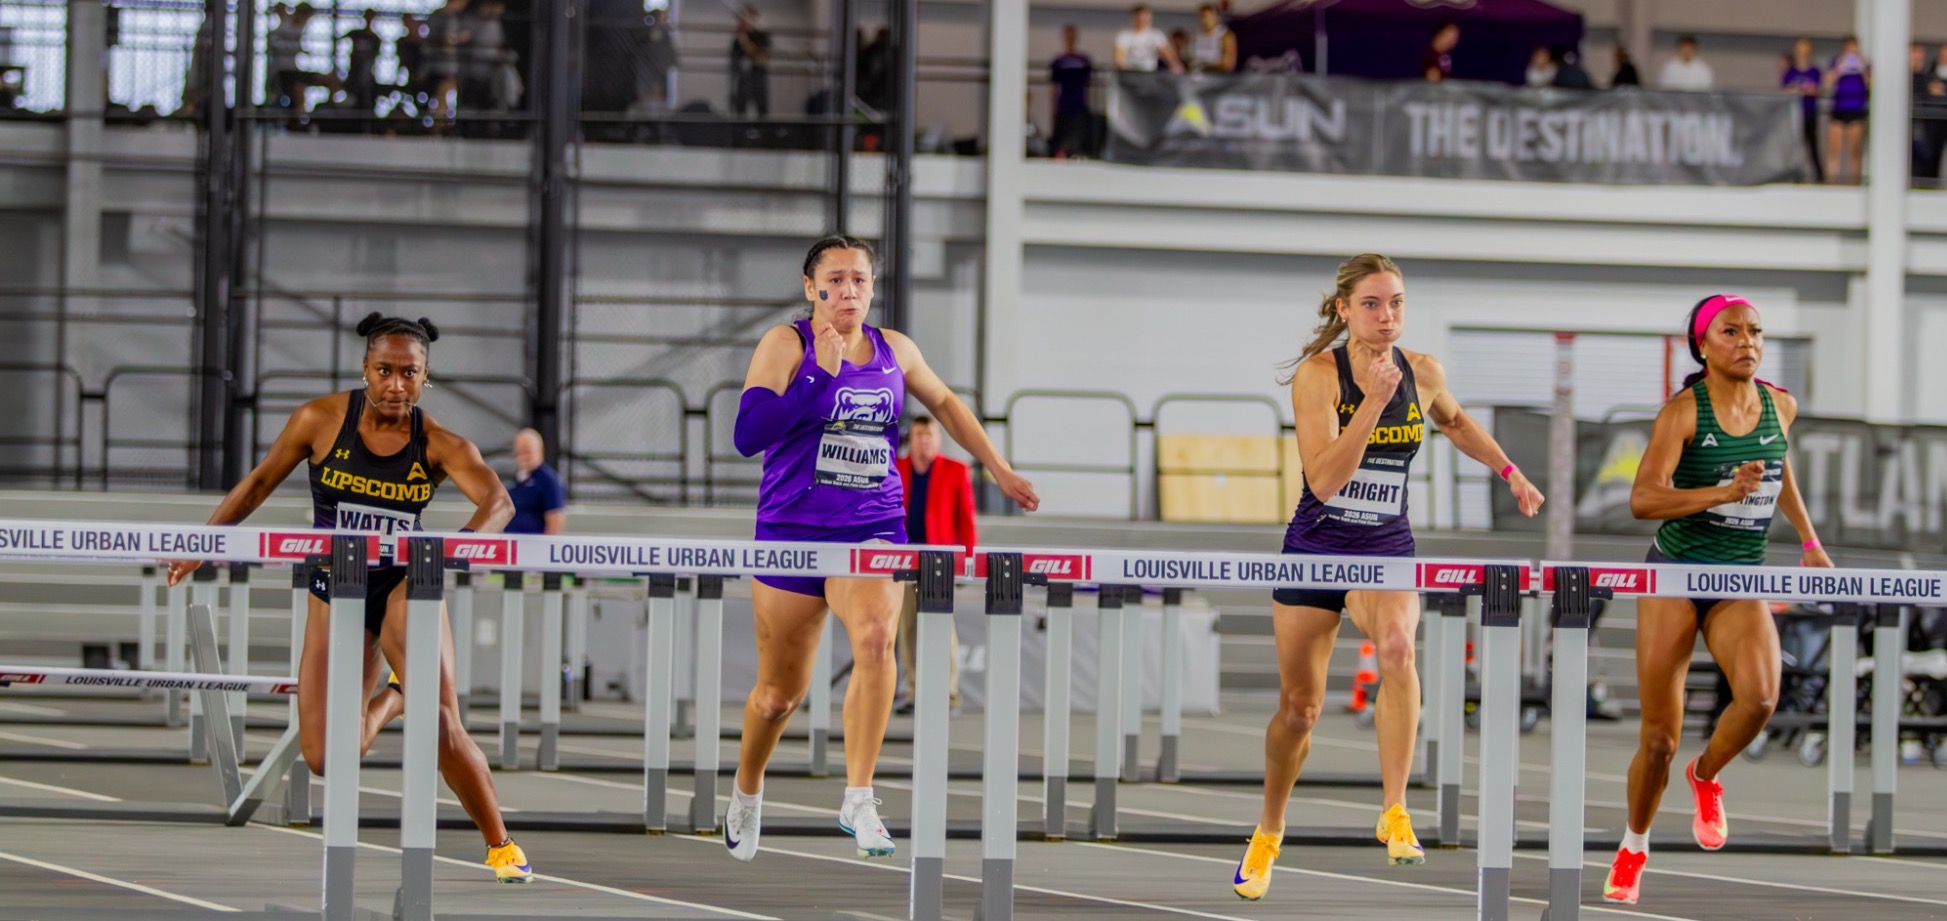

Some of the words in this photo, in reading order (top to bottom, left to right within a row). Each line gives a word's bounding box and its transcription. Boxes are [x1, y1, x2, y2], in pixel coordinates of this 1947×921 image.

[1163, 97, 1347, 141] ASUN
[1404, 102, 1481, 158] THE
[821, 443, 887, 465] WILLIAMS
[321, 467, 431, 502] LIPSCOMB
[340, 510, 411, 535] WATTS
[71, 530, 141, 551] URBAN
[149, 533, 226, 554] LEAGUE
[279, 538, 323, 554] GILL
[453, 543, 498, 559] GILL
[550, 544, 660, 566] LOUISVILLE
[667, 547, 735, 567] URBAN
[742, 549, 818, 569] LEAGUE
[869, 554, 912, 569] GILL
[1029, 559, 1072, 574] GILL
[1123, 559, 1231, 580] LOUISVILLE
[1238, 562, 1304, 582] URBAN
[1311, 563, 1384, 584] LEAGUE
[1435, 569, 1477, 584] GILL
[1595, 573, 1638, 588] GILL
[1687, 573, 1792, 594] LOUISVILLE
[1799, 576, 1863, 596] URBAN
[1870, 577, 1941, 598] LEAGUE
[65, 675, 143, 687] LOUISVILLE
[146, 678, 195, 690] URBAN
[197, 681, 251, 692] LEAGUE
